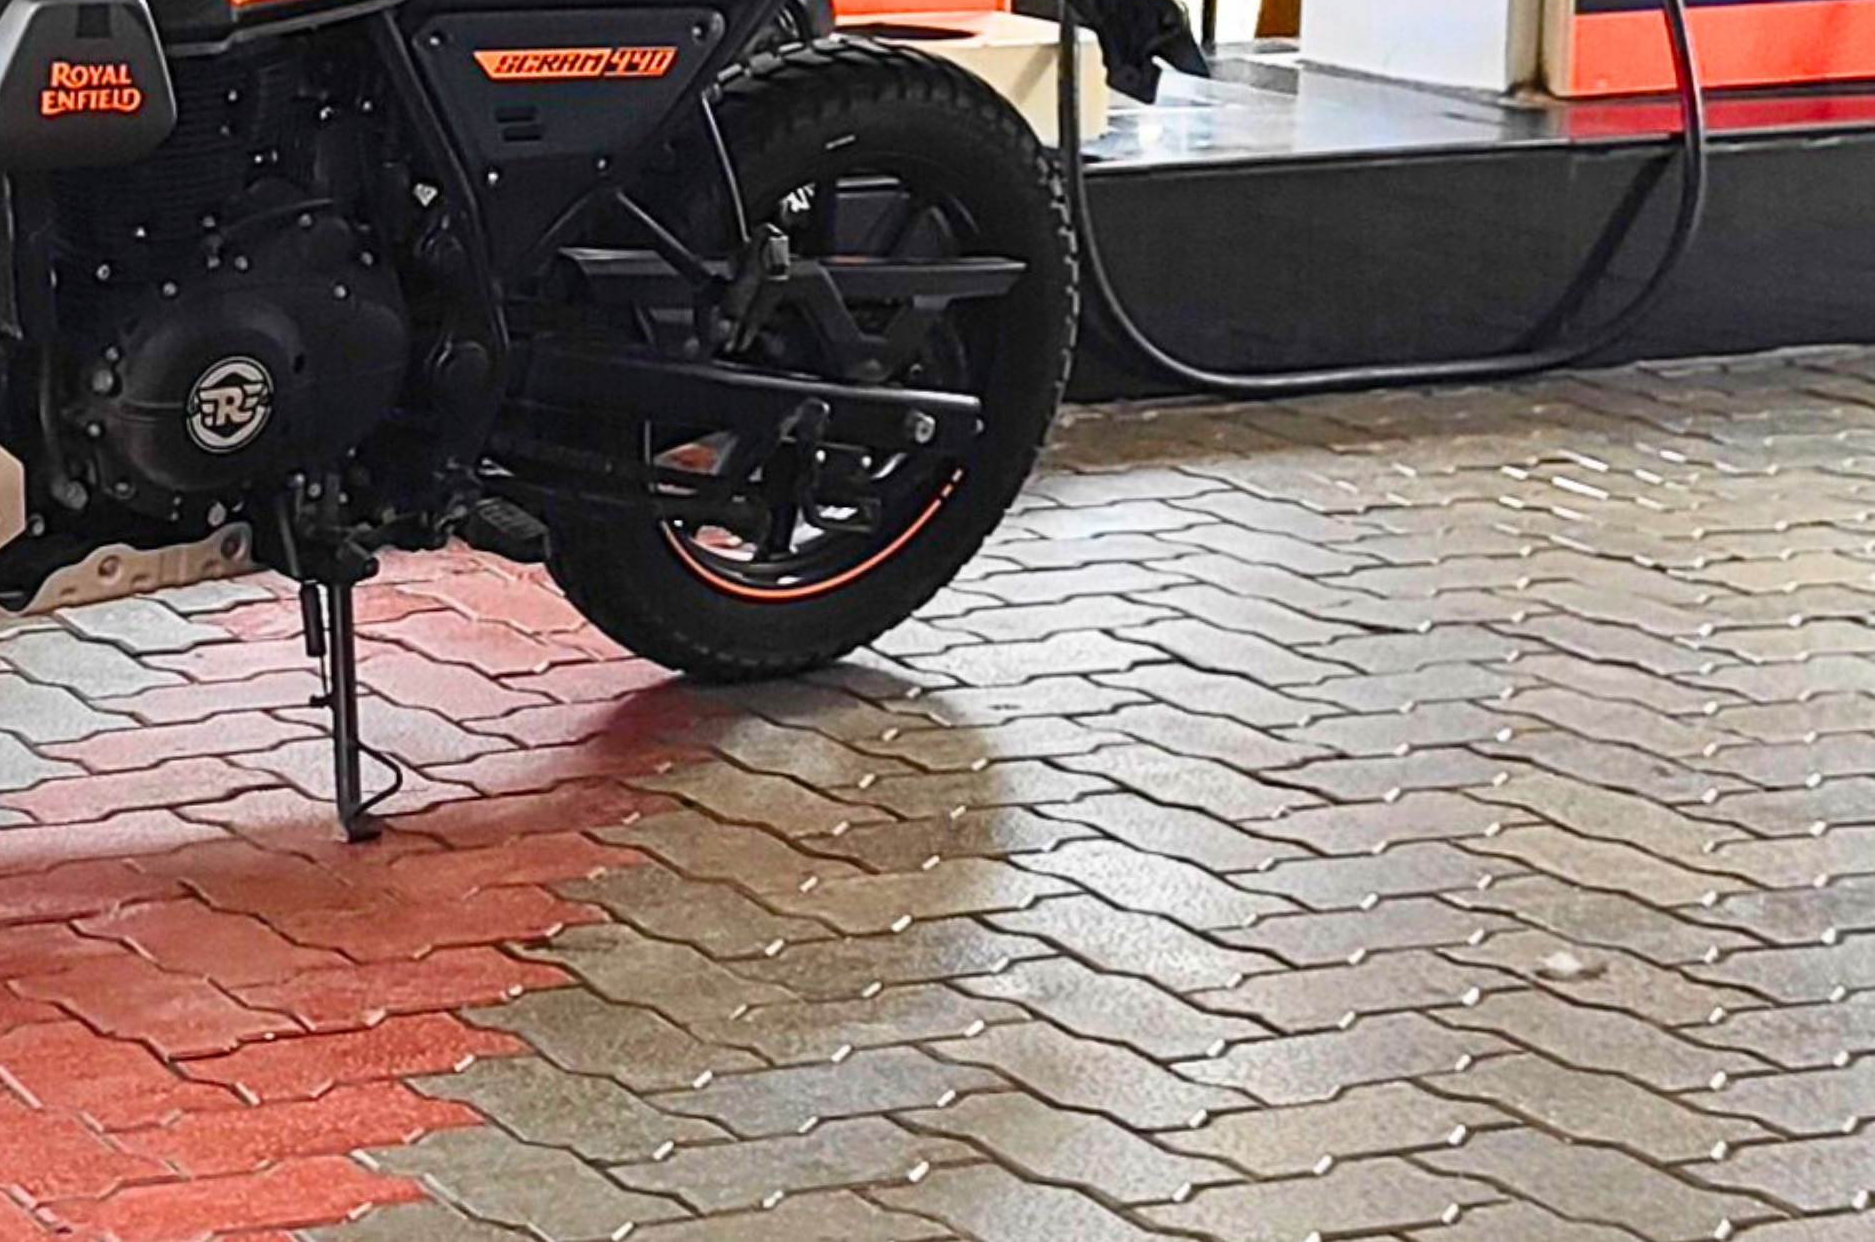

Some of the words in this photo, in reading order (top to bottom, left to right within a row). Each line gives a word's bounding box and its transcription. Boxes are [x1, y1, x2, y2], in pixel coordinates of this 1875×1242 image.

[51, 61, 132, 89] ROYAL
[492, 52, 606, 75] SCRAM
[606, 47, 677, 77] 440
[40, 88, 142, 116] ENFIELD
